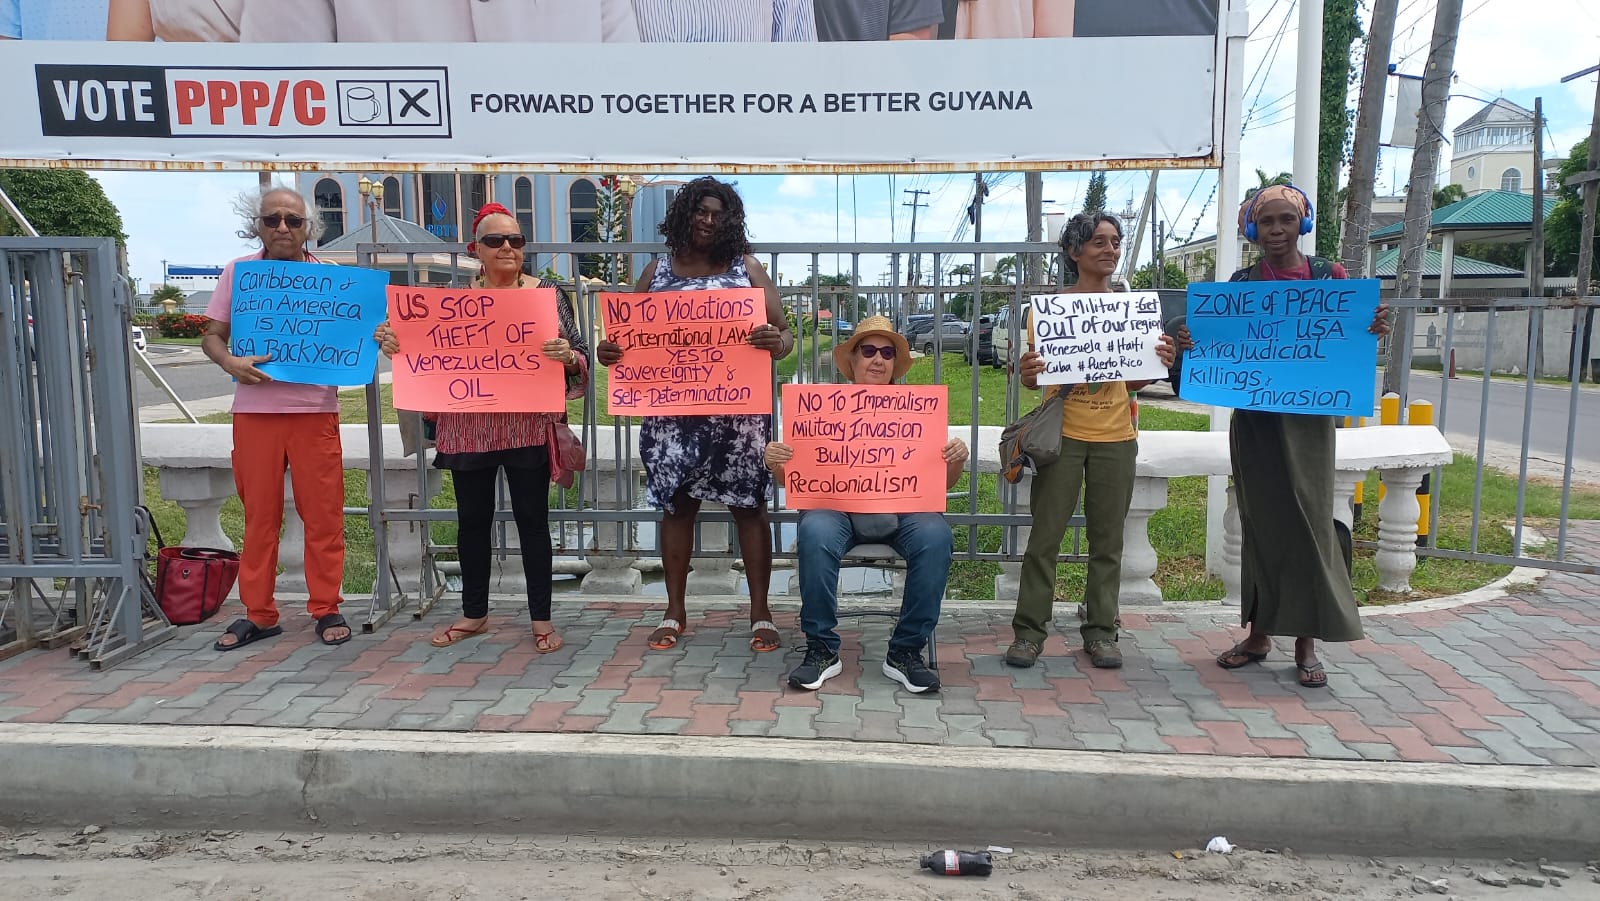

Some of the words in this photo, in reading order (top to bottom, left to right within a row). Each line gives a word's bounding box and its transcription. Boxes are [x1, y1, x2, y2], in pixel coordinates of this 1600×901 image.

[53, 80, 155, 122] VOTE
[174, 79, 326, 127] PPP/C
[471, 94, 594, 114] FORWARD
[601, 94, 735, 114] TOGETHER
[743, 93, 792, 113] FOR
[799, 93, 817, 113] A
[825, 92, 921, 112] BETTER
[928, 90, 1033, 111] GUYANA
[396, 293, 429, 320] US
[439, 295, 495, 321] STOP
[608, 298, 631, 324] NO
[1034, 296, 1066, 316] US
[1193, 291, 1256, 316] ZONE
[1283, 287, 1357, 315] PEACE
[254, 317, 274, 331] IS
[280, 319, 336, 336] NOT
[427, 320, 496, 348] THEFT
[506, 322, 536, 344] OF
[1081, 316, 1102, 334] of
[1102, 319, 1128, 334] our
[1296, 318, 1344, 340] USA
[406, 349, 540, 373] Venezuela's
[666, 348, 700, 364] YES
[1041, 361, 1072, 375] Cuba
[1120, 356, 1143, 369] Rico
[615, 363, 713, 383] Sovereignty
[449, 378, 494, 400] OIL
[1247, 386, 1351, 408] Invasion
[798, 392, 822, 413] NO
